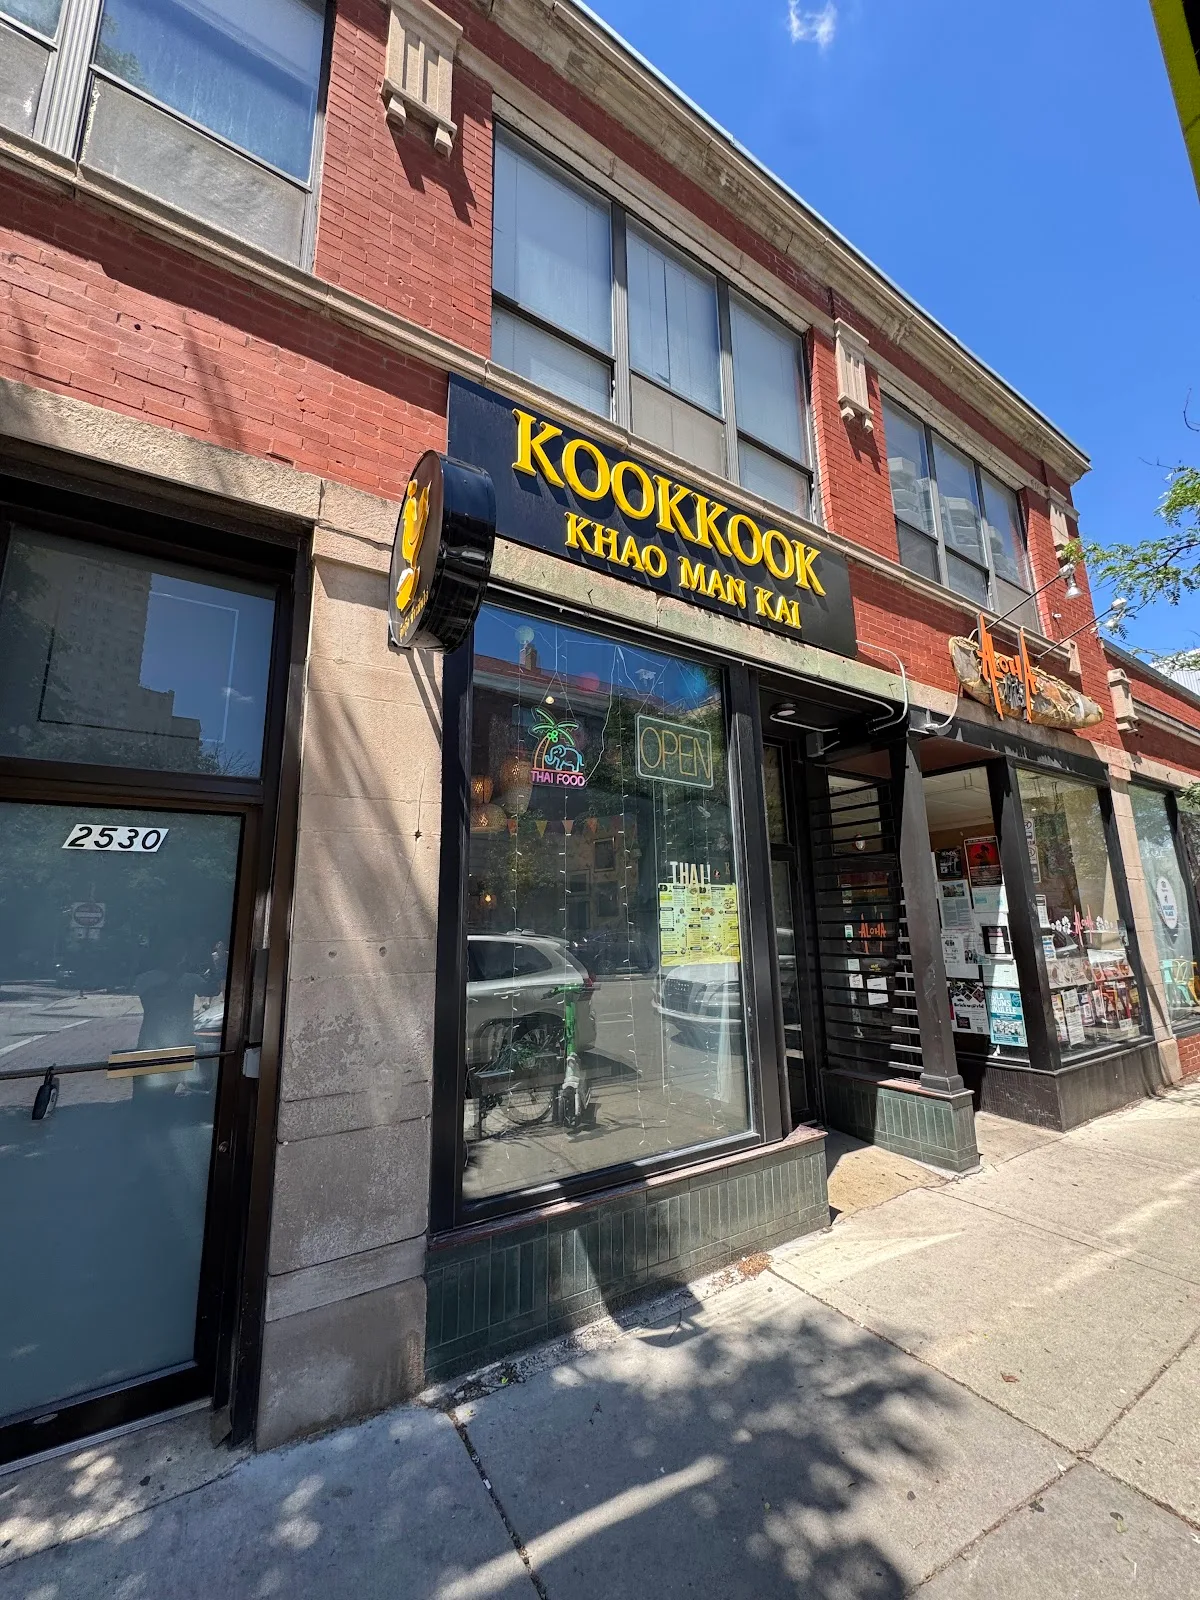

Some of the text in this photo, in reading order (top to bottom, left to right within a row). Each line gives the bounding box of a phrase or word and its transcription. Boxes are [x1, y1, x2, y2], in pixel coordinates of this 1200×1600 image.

[512, 408, 826, 596] KOOKKOOK
[564, 512, 802, 629] KHAO MAN KAI
[640, 727, 711, 778] OPEN
[531, 770, 585, 787] THAI FOOD
[68, 826, 160, 850] 2530
